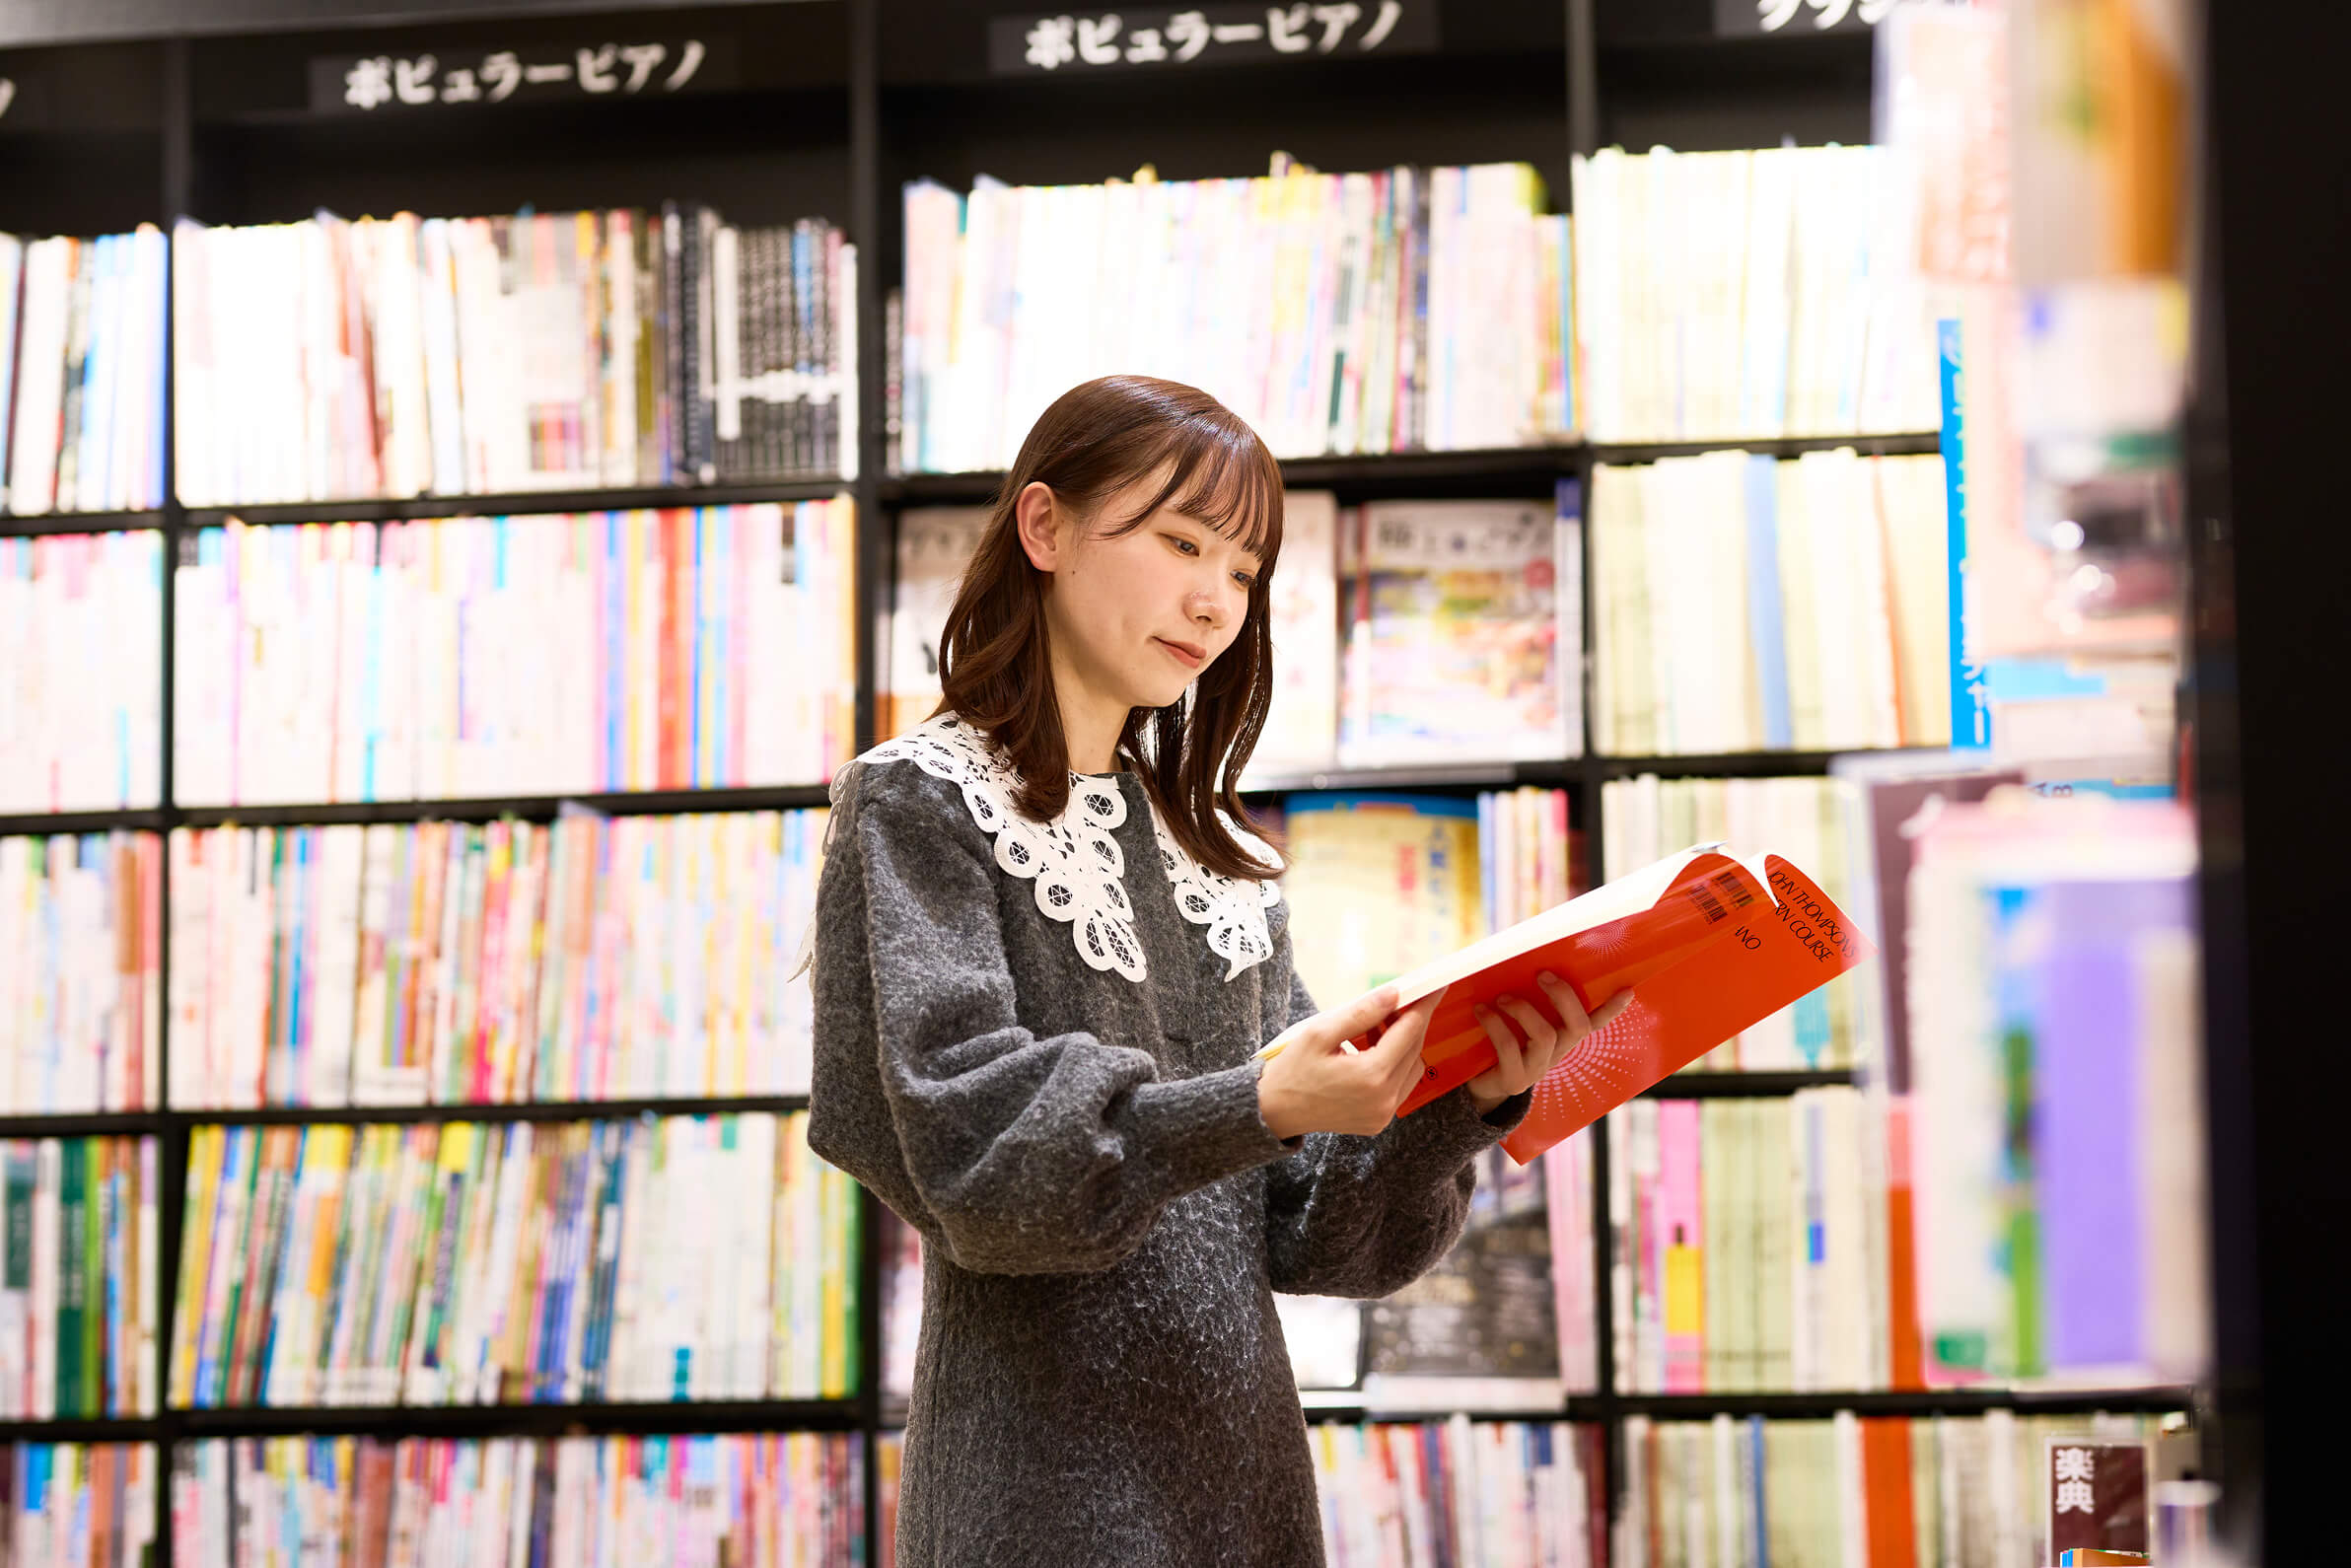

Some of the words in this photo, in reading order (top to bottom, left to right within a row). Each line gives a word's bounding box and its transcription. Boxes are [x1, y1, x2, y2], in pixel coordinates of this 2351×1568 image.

[1026, 1, 1402, 70] ポピュラーピアノ
[344, 39, 706, 110] ポピュラーピアノ
[1789, 919, 1834, 963] COURSE
[2055, 1447, 2095, 1515] 楽典
